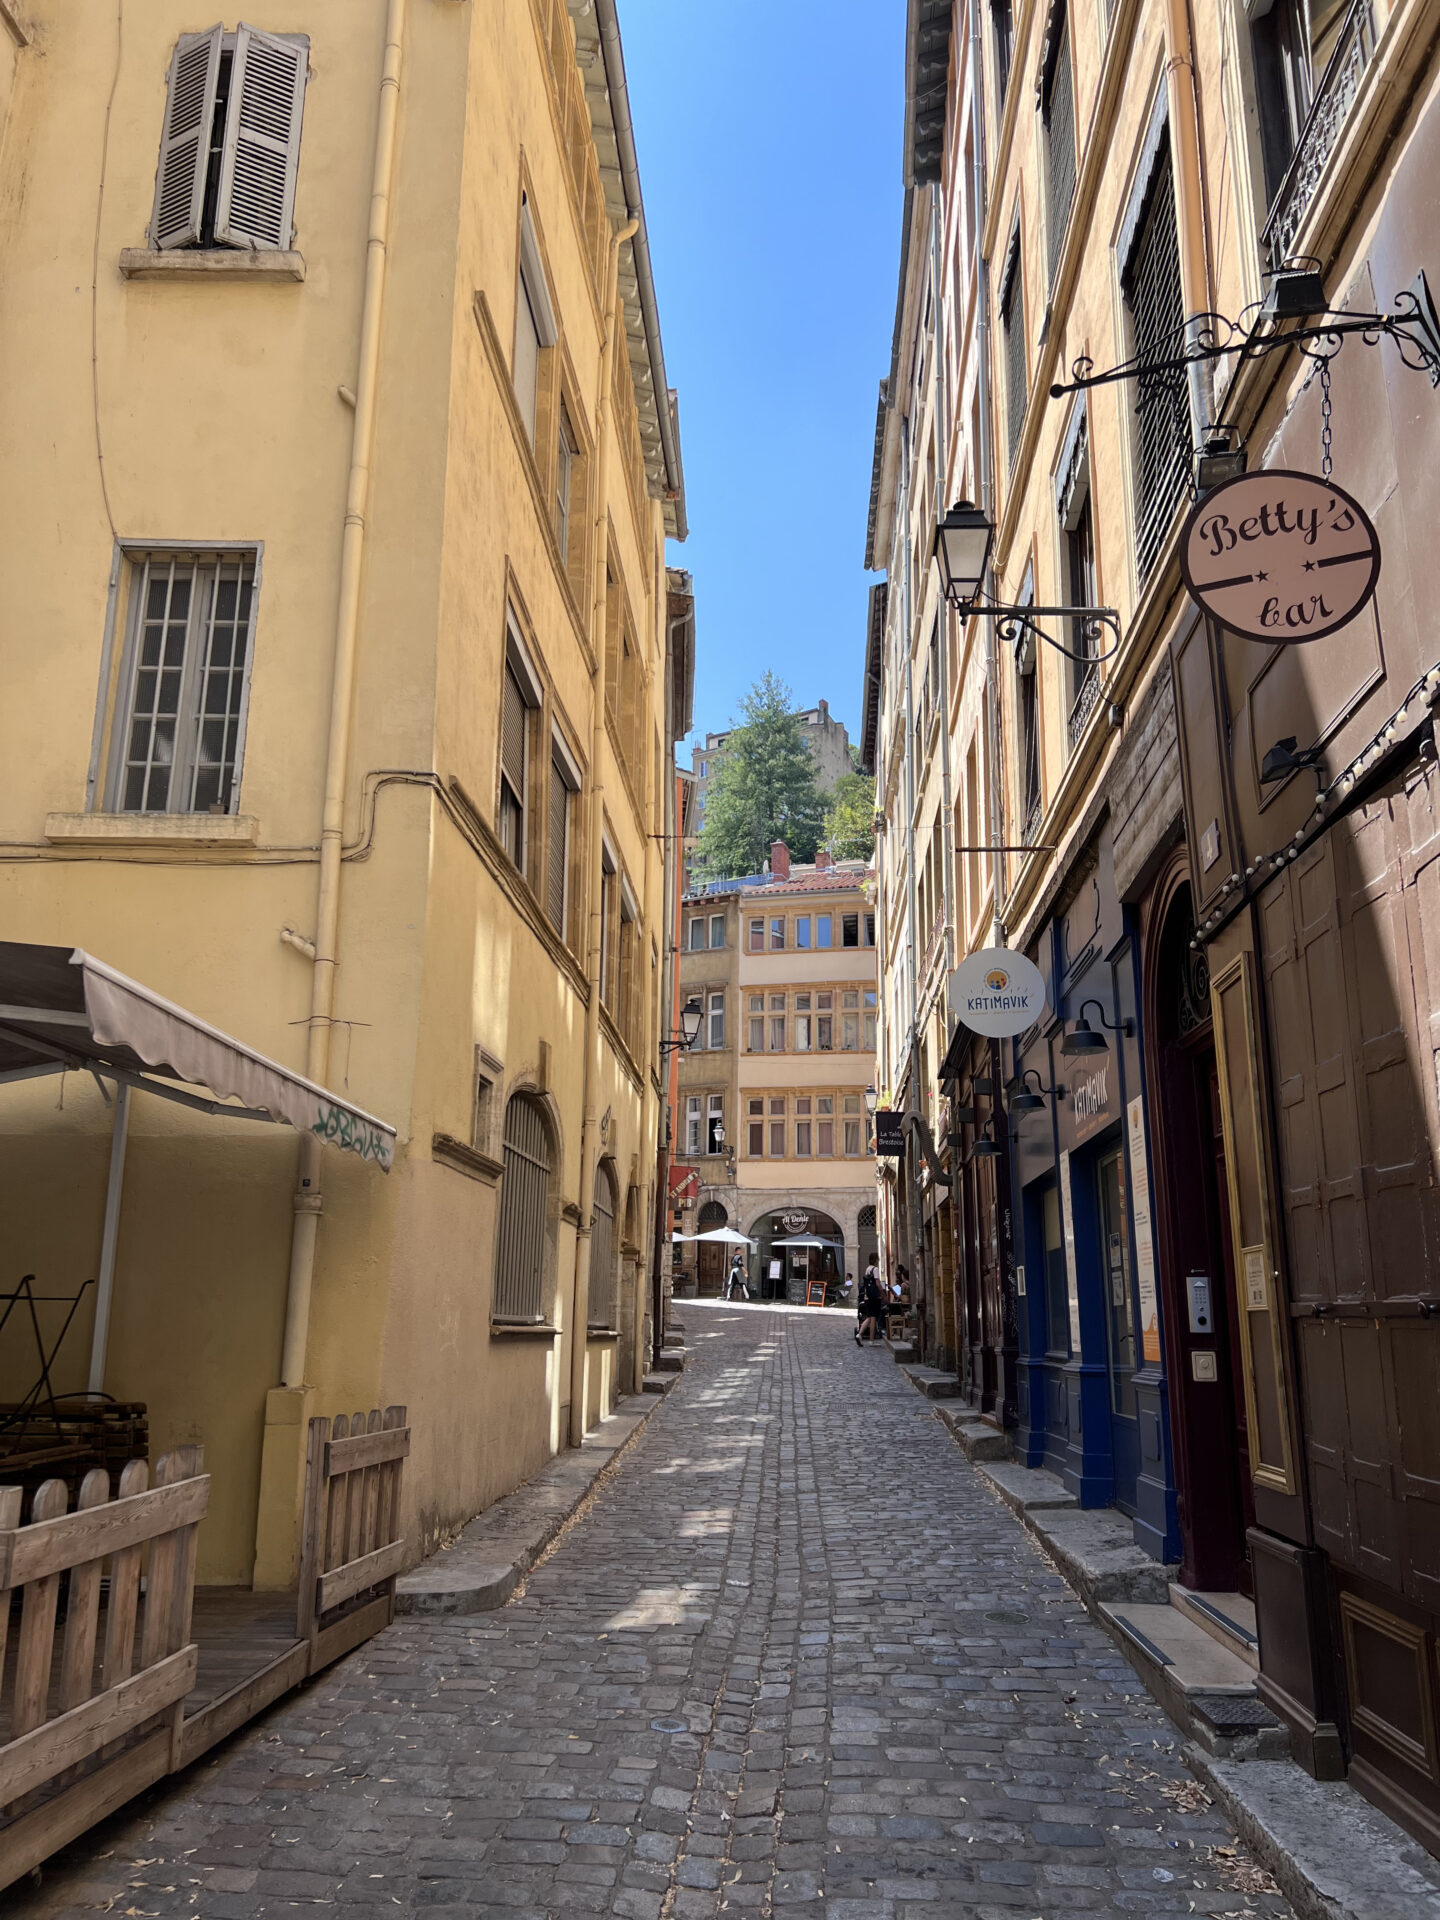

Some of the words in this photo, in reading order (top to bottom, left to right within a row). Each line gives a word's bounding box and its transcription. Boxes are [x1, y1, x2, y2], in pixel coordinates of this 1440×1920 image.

[1200, 499, 1355, 557] Betty's
[1256, 594, 1333, 627] bar
[968, 996, 1029, 1011] KATIMAVIK
[1074, 1067, 1108, 1126] KATIMAVIK
[782, 1215, 790, 1224] Al
[791, 1215, 809, 1223] Dente
